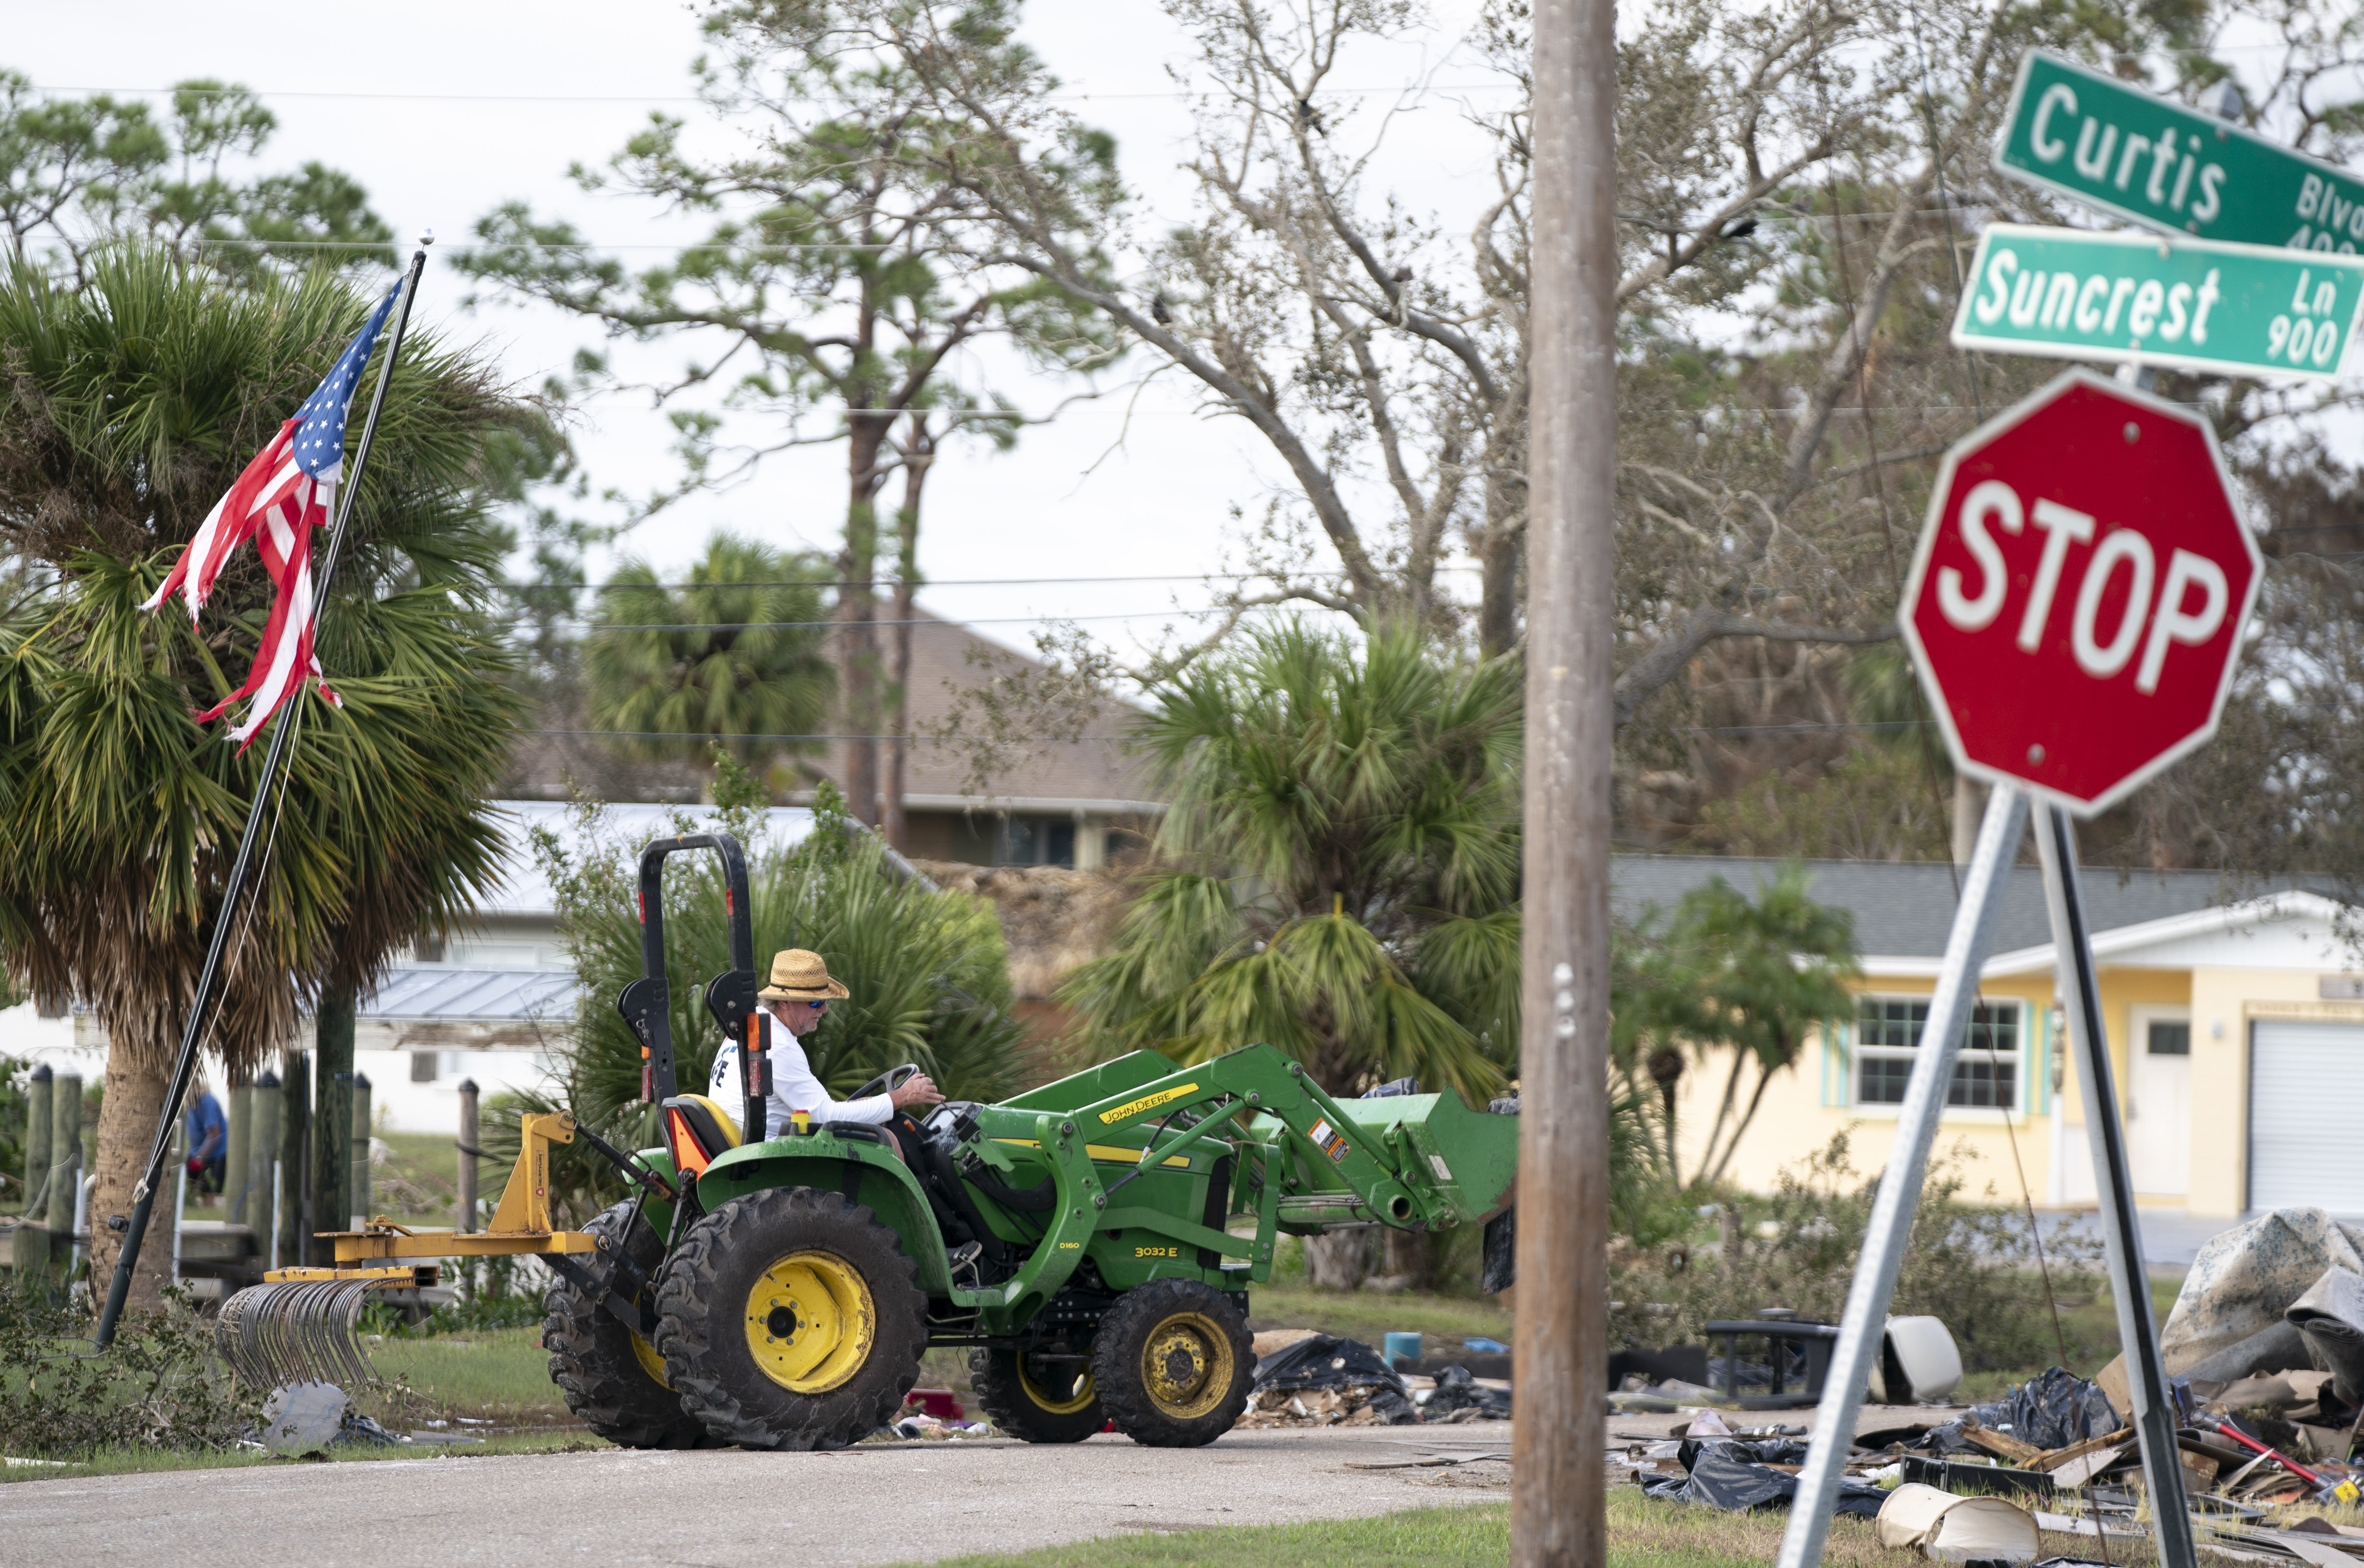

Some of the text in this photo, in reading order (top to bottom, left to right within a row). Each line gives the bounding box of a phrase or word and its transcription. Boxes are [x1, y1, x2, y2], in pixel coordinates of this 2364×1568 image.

[2031, 83, 2227, 223] Curtis
[1974, 248, 2221, 345] Suncrest
[2291, 268, 2337, 317] Ln
[2267, 314, 2338, 367] 900
[1936, 479, 2229, 697] STOP
[1106, 1092, 1171, 1123] JOHN DEERE
[1134, 1247, 1178, 1258] 3032 E
